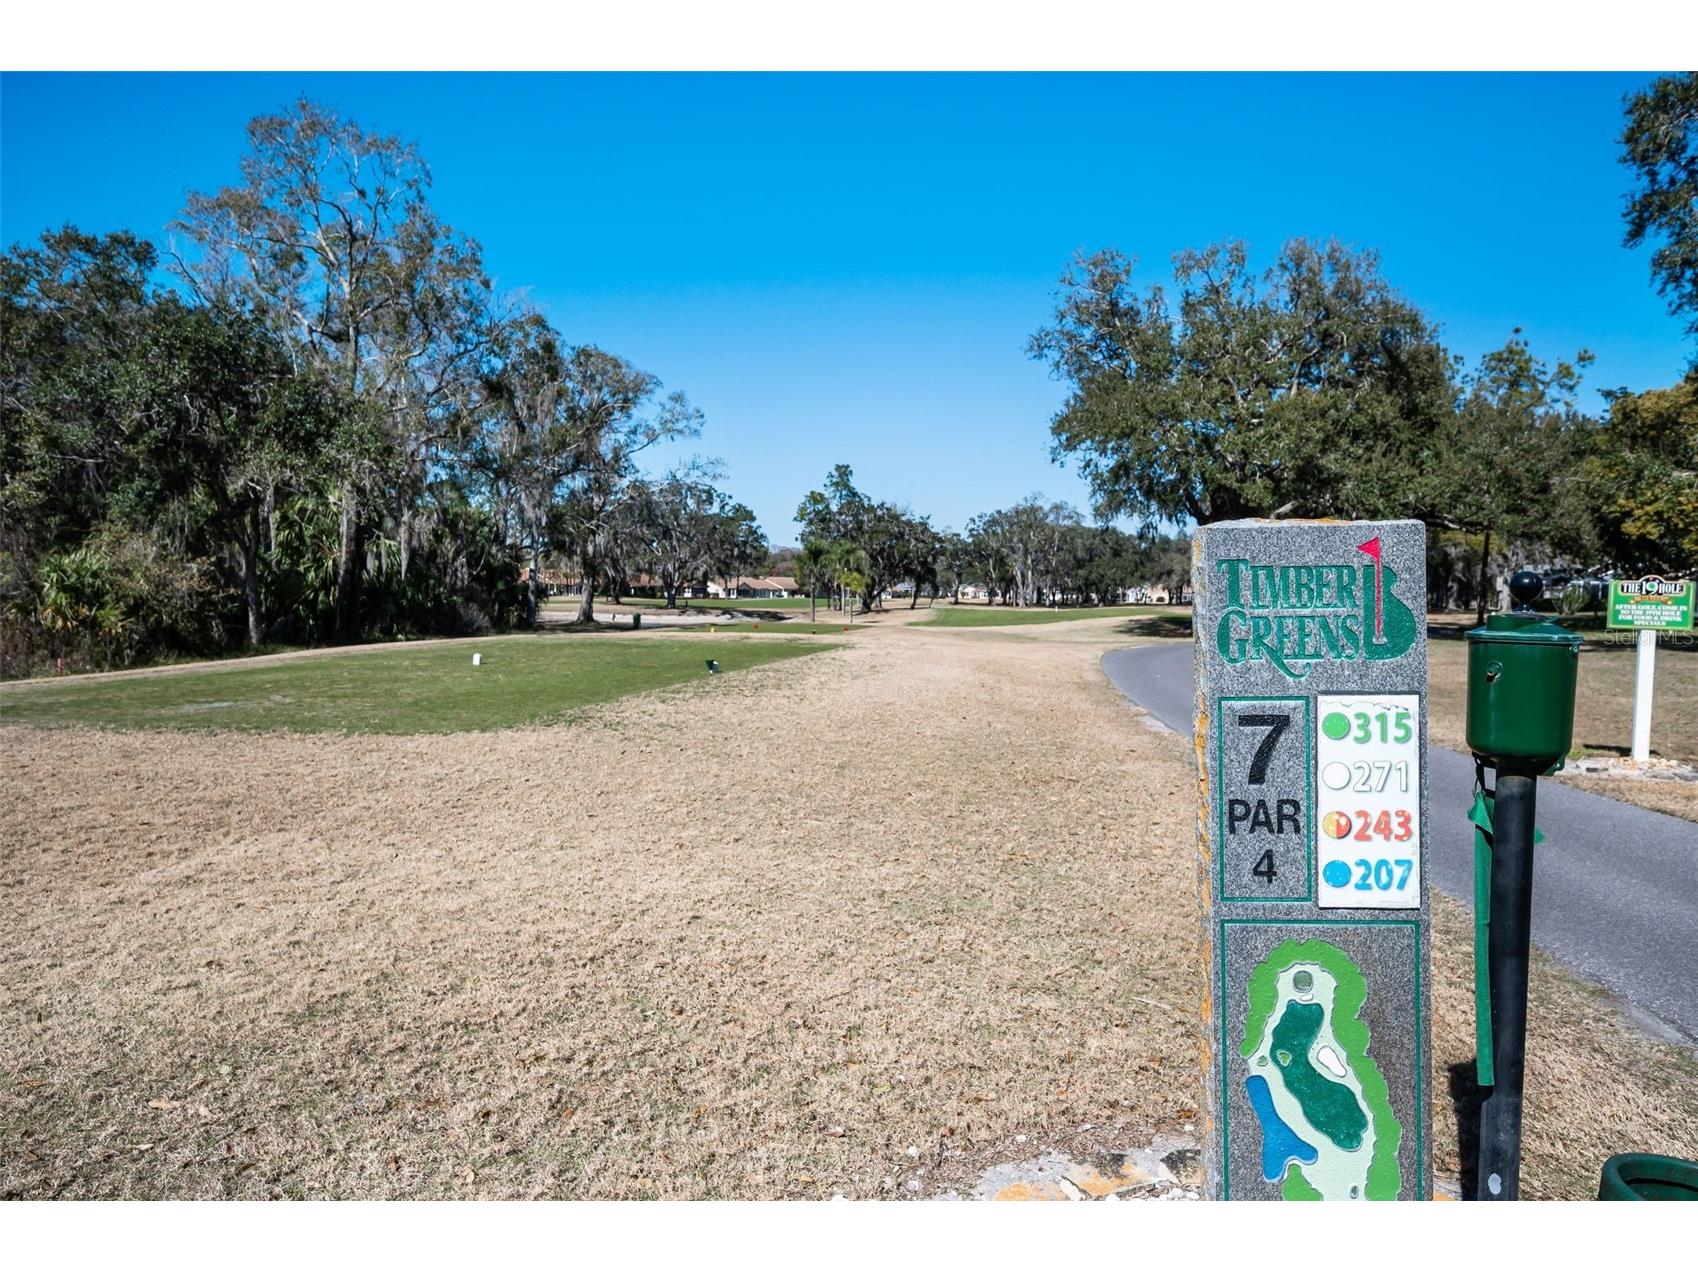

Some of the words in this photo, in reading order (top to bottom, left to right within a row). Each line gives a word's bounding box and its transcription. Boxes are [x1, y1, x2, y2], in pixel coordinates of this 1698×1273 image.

[1216, 559, 1358, 608] TIMBER
[1623, 583, 1641, 593] THE
[1642, 581, 1659, 595] 19
[1659, 583, 1682, 594] HOLE
[1216, 611, 1361, 679] GREENS
[1353, 712, 1412, 744] 315
[1238, 715, 1290, 785] 7
[1352, 760, 1408, 792] 271
[1228, 799, 1300, 834] PAR
[1353, 809, 1412, 842] 243
[1252, 850, 1277, 884] 4
[1354, 858, 1413, 891] 207
